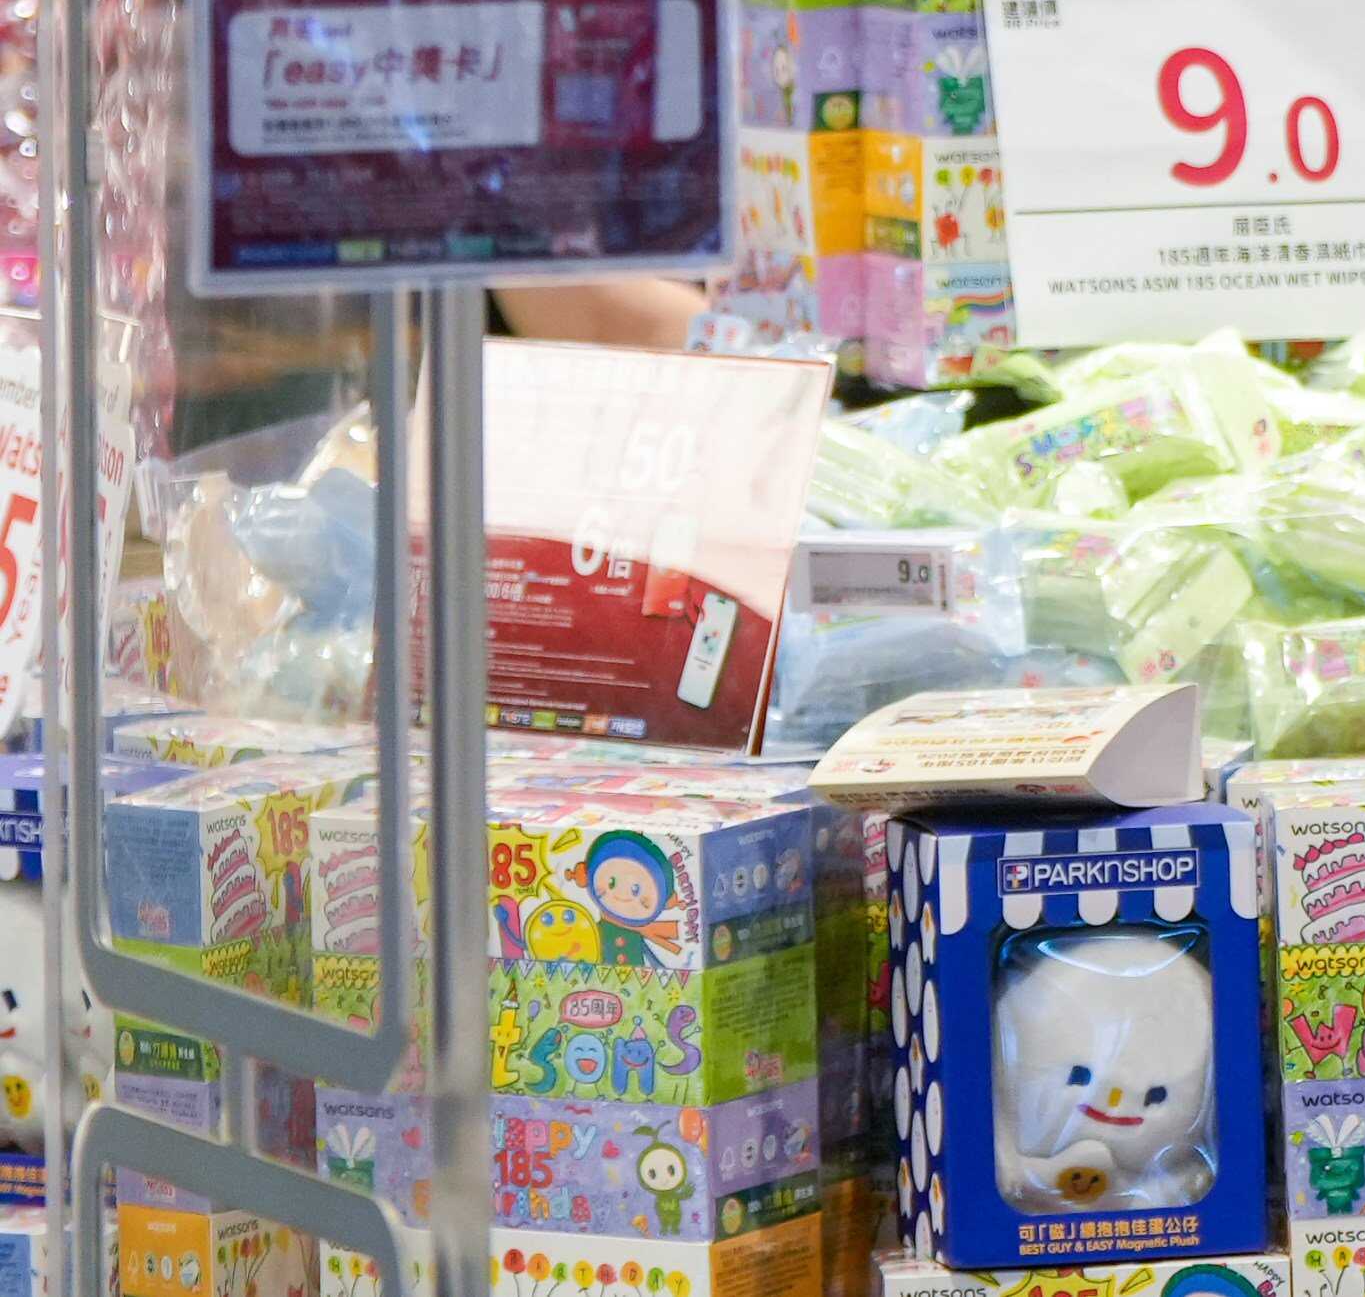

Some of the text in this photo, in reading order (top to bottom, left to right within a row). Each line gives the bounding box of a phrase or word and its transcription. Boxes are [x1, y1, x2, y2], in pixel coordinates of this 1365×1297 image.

[1157, 47, 1341, 187] 9.0
[1048, 278, 1137, 295] WATSONS
[1143, 276, 1179, 291] ASW
[1187, 275, 1215, 290] 185
[1219, 273, 1280, 290] OCEAN
[1287, 271, 1319, 287] WET
[897, 559, 930, 584] 9.0
[206, 815, 247, 834] watsons
[267, 806, 310, 855] 185
[490, 842, 538, 890] 85
[323, 1103, 396, 1121] watsons
[494, 1150, 554, 1189] 185
[216, 1219, 259, 1240] watsons
[1018, 1234, 1199, 1256] BEST GUY & EASY Magnetic Plush
[1254, 1260, 1286, 1286] HAPPY
